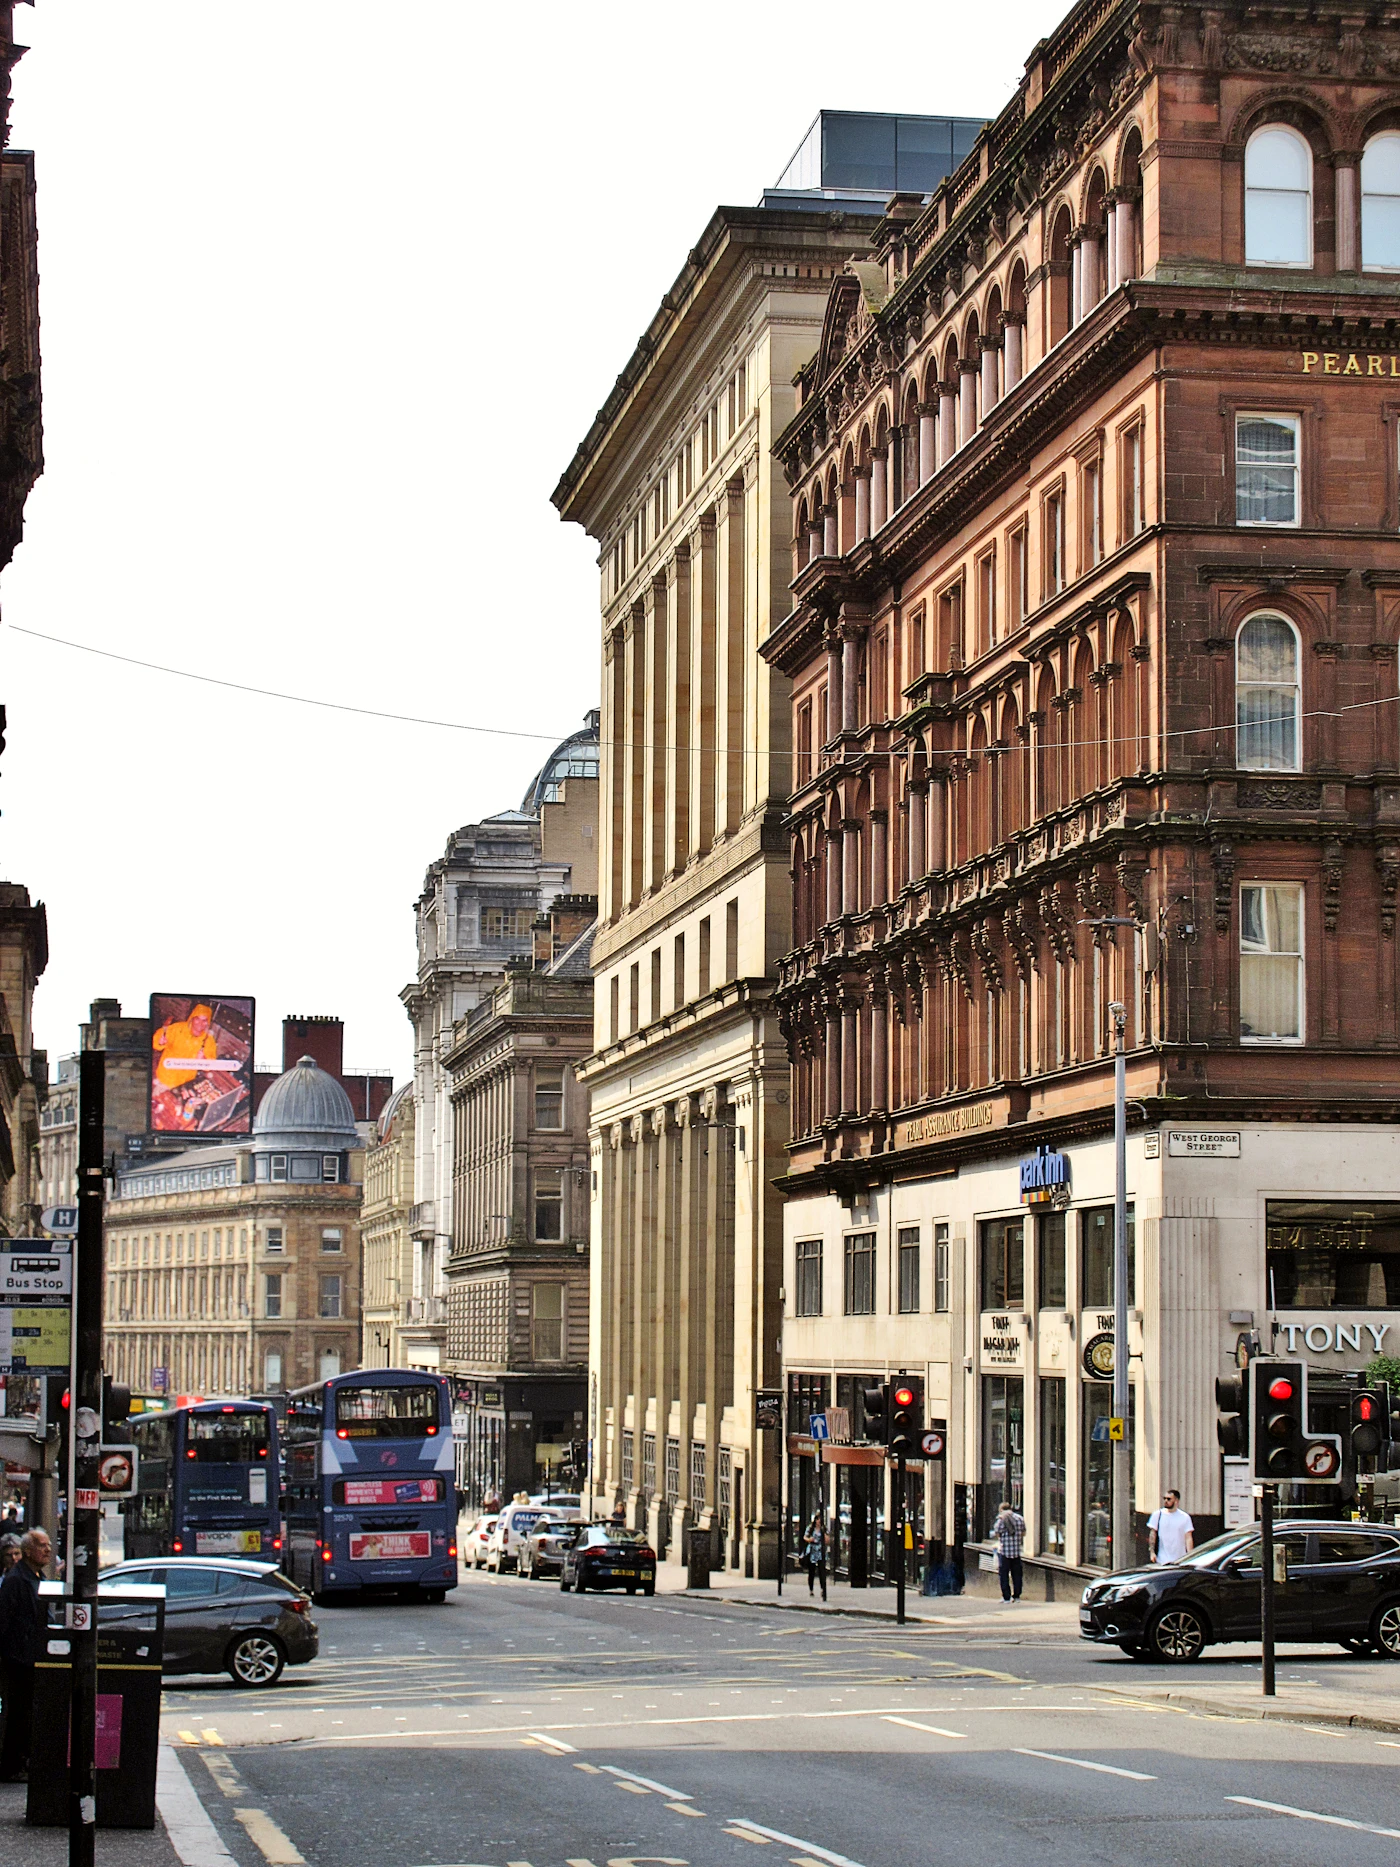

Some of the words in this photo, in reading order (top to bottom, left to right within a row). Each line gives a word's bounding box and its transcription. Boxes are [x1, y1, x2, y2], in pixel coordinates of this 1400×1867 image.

[1301, 351, 1400, 377] PEARL
[905, 1120, 924, 1142] PEARL
[925, 1111, 960, 1138] ASSURANCE
[961, 1103, 993, 1130] BUILDINGS
[1172, 1133, 1198, 1142] WEST
[1200, 1134, 1238, 1142] GEORGE
[1186, 1142, 1223, 1151] STREET
[1020, 1146, 1045, 1203] park
[1045, 1145, 1064, 1185] inn
[58, 1211, 70, 1225] H
[6, 1278, 29, 1288] Bus
[34, 1278, 63, 1290] Stop
[1088, 1336, 1114, 1350] MACARO
[1280, 1323, 1391, 1352] TONY
[383, 1535, 411, 1546] THINK
